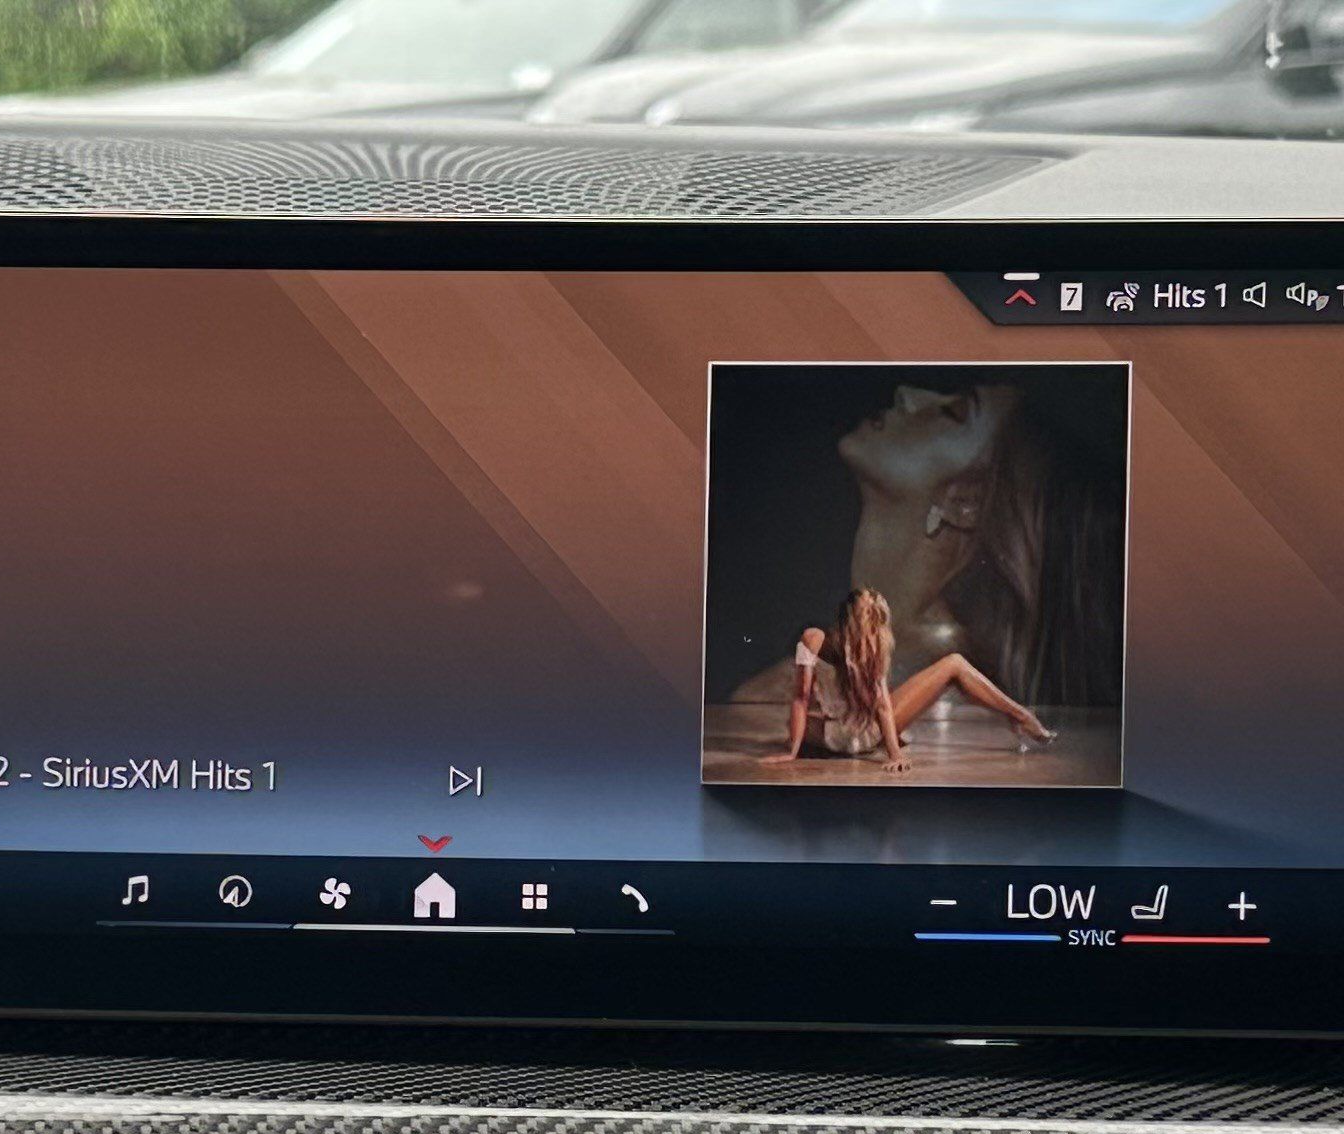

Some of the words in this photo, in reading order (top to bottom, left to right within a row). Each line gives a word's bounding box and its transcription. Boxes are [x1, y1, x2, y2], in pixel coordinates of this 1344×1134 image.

[1153, 283, 1206, 309] Hits
[1214, 282, 1227, 308] 1
[42, 755, 180, 790] SiriusXM
[189, 758, 254, 792] Hits
[262, 759, 277, 792] 1
[1007, 883, 1096, 921] LOW
[1068, 929, 1116, 947] SYNC
